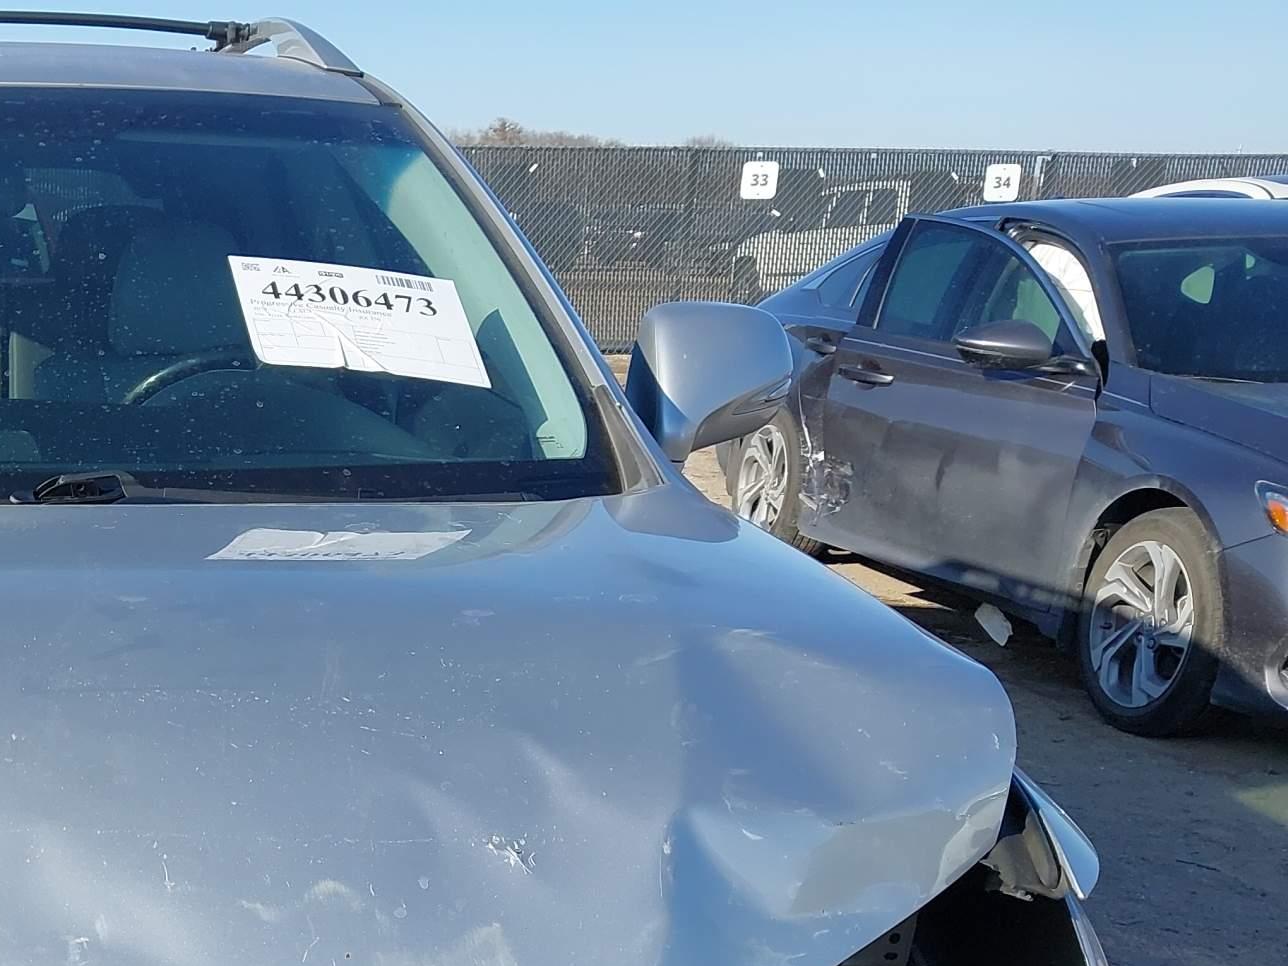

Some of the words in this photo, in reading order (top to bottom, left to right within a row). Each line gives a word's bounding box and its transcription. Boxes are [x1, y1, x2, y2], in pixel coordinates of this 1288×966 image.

[750, 173, 769, 187] 33
[993, 176, 1011, 189] 34
[261, 280, 438, 317] 44306473
